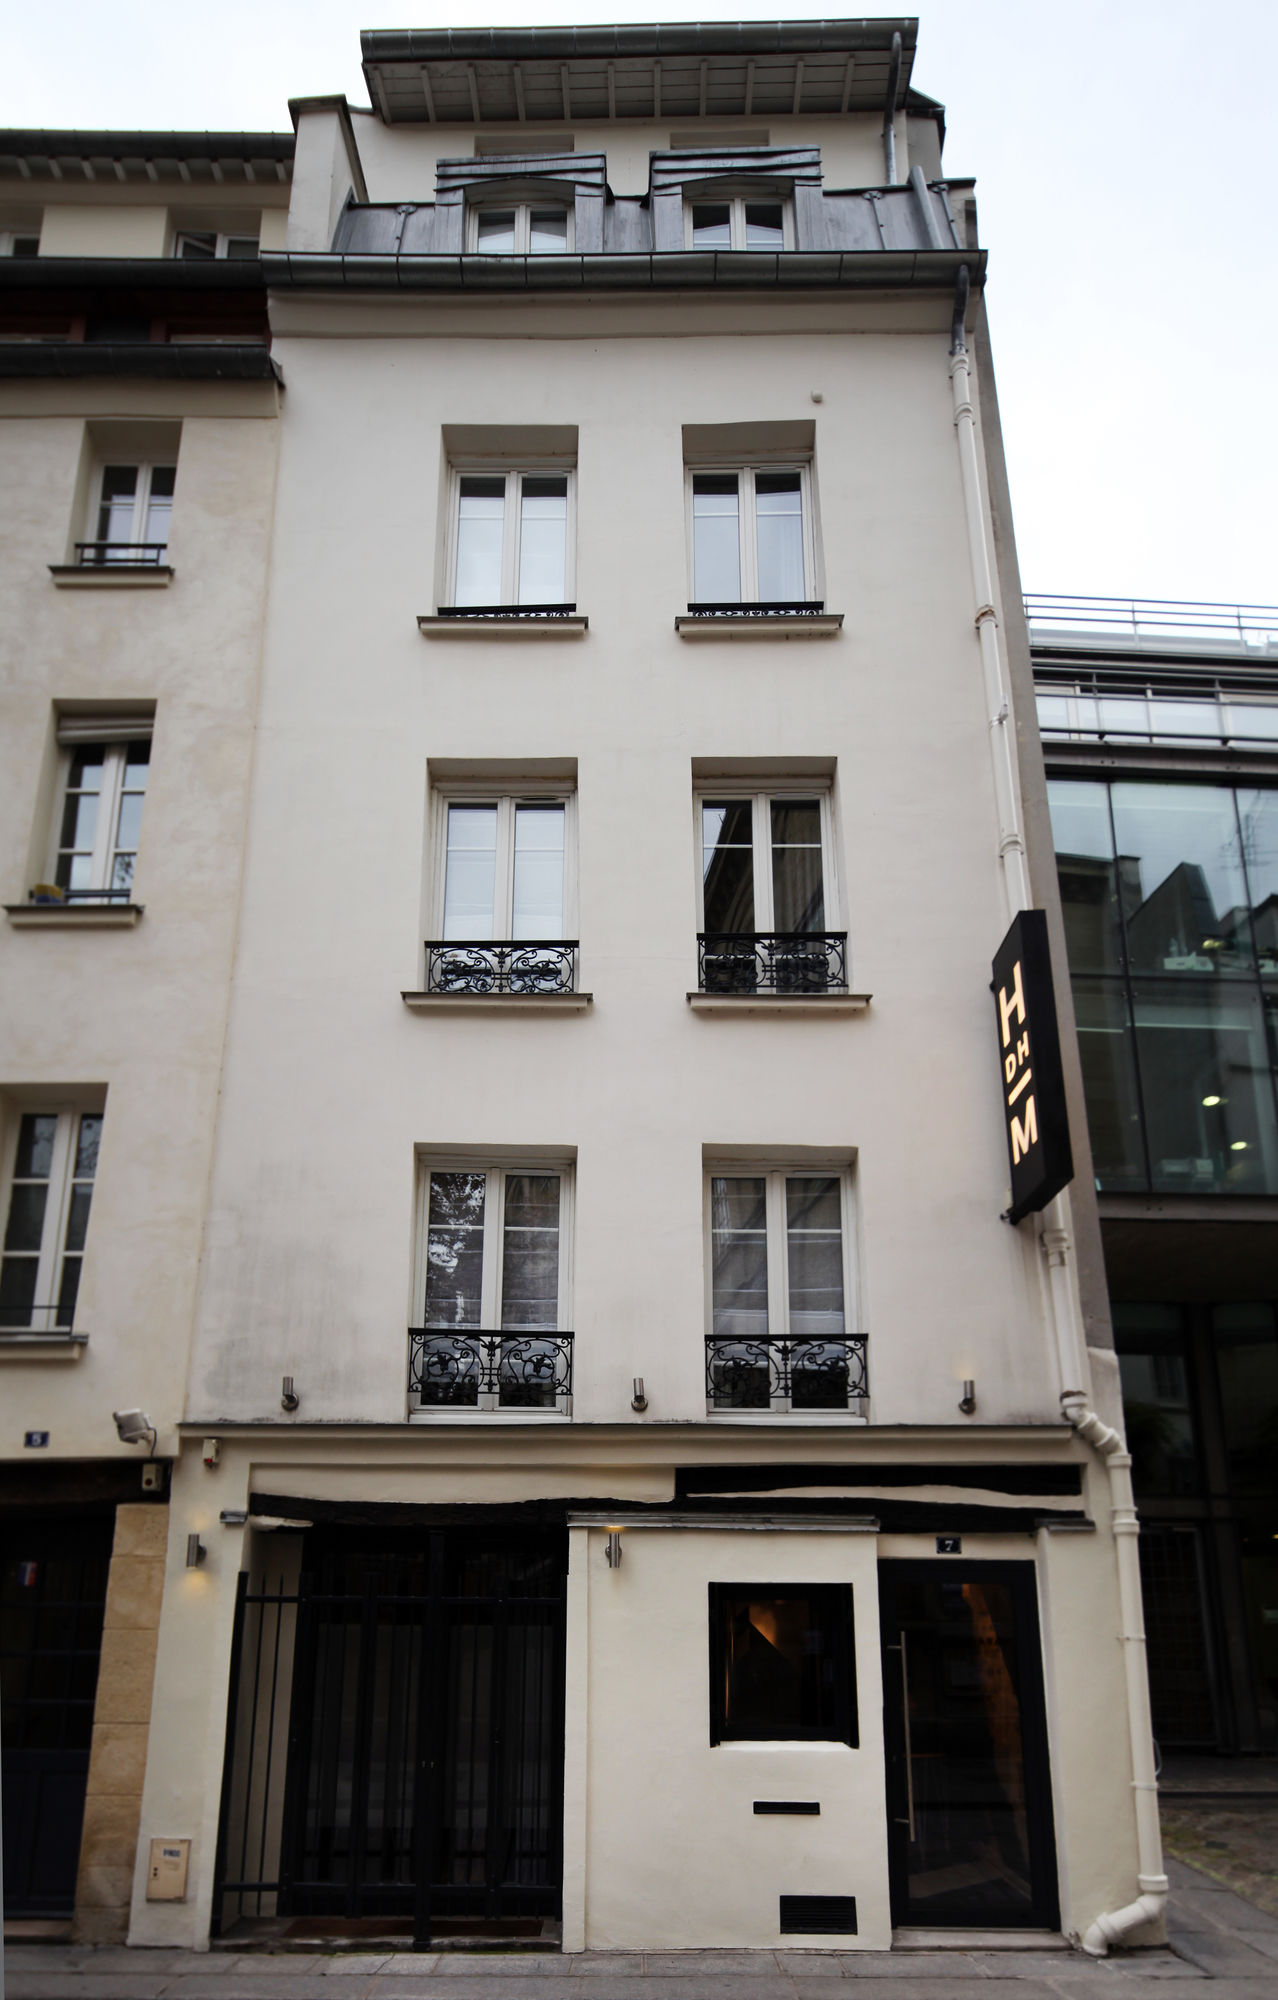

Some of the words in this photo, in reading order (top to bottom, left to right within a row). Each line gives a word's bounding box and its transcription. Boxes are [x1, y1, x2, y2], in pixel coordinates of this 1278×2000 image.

[999, 960, 1026, 1048] H
[1010, 1094, 1038, 1165] M
[945, 1540, 954, 1551] 7
